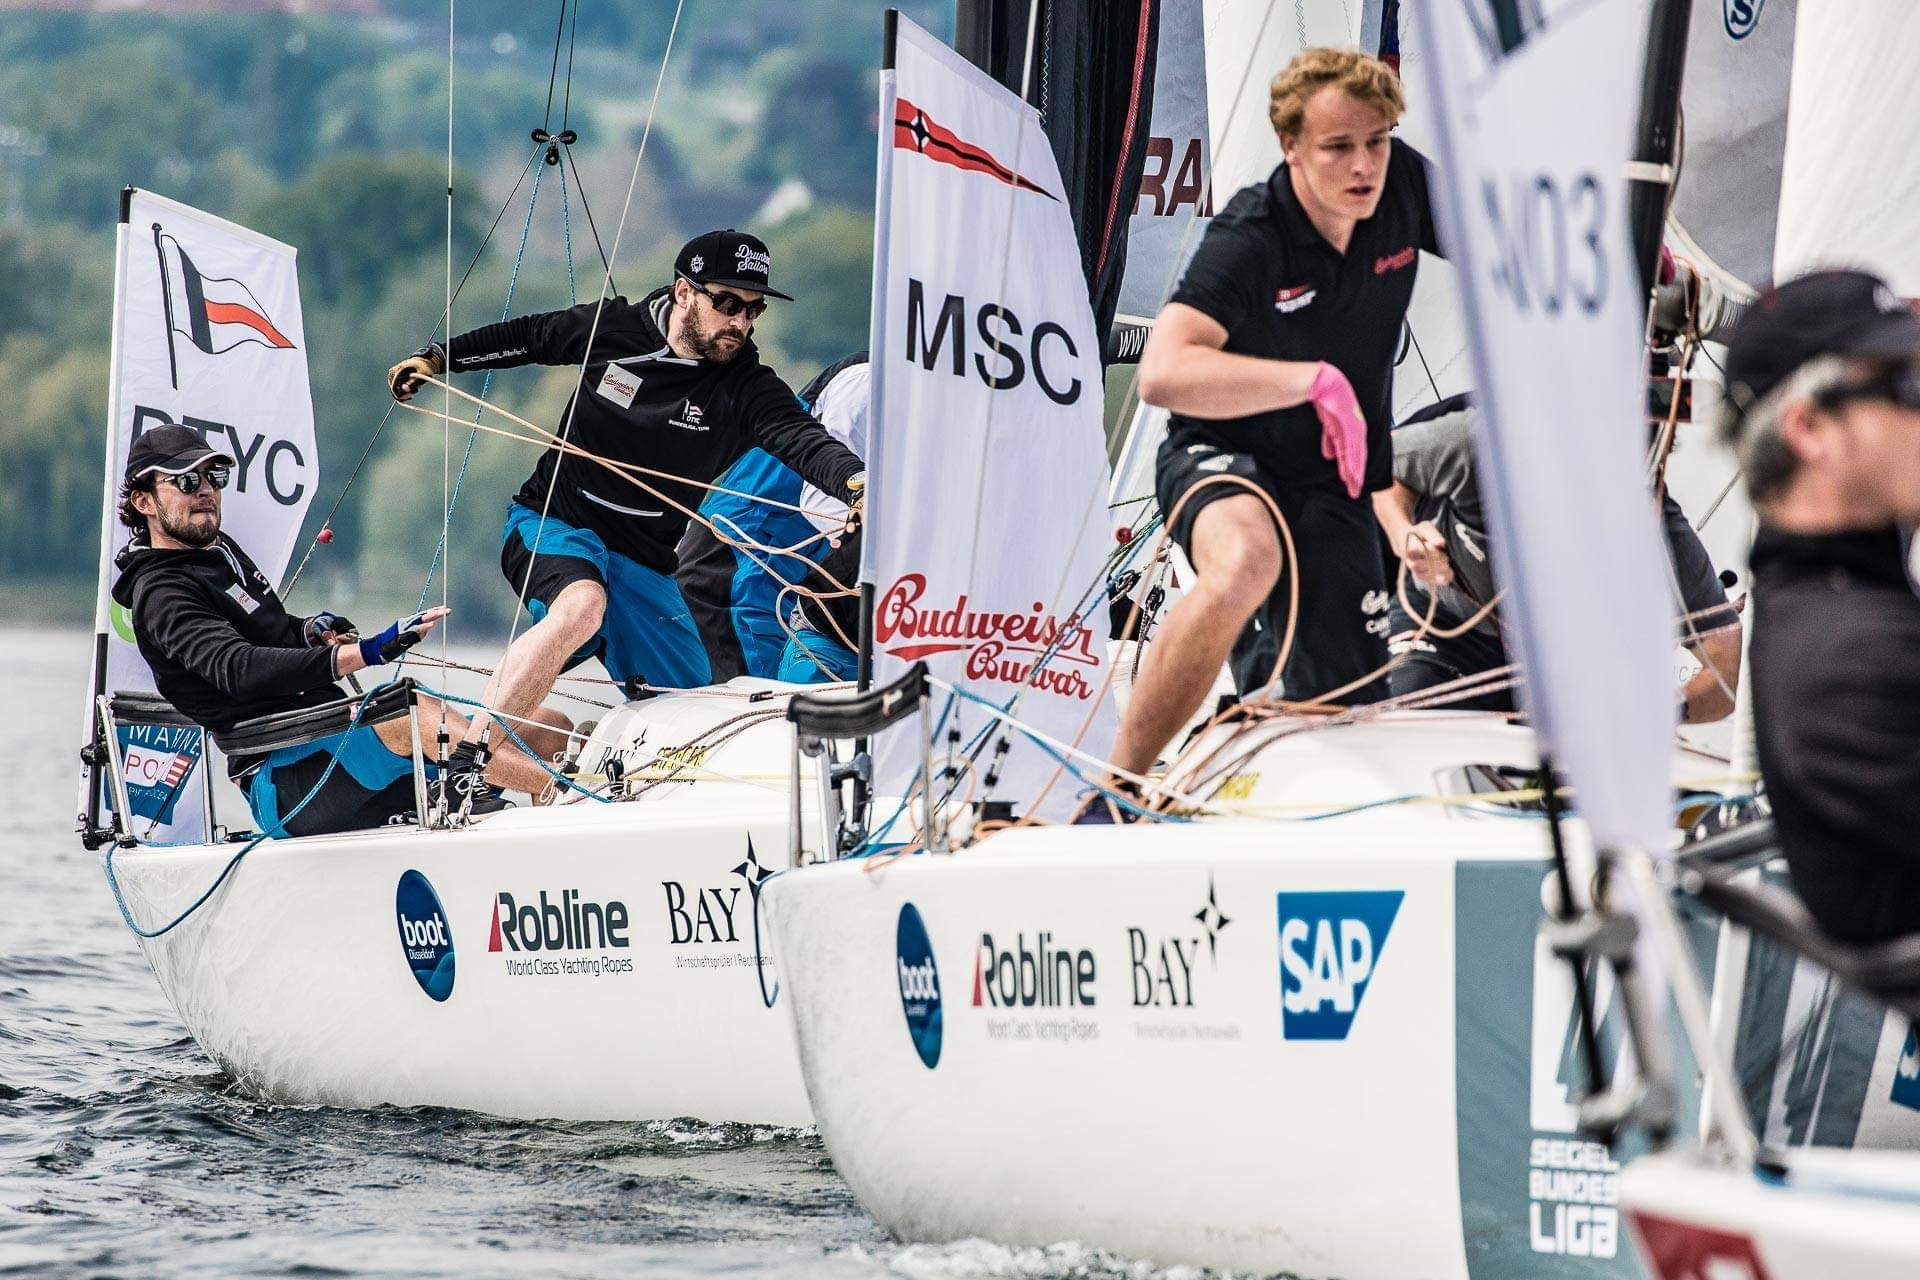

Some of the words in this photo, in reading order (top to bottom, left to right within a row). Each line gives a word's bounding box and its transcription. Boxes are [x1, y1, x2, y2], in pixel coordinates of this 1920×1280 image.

[1131, 136, 1213, 217] RA
[906, 277, 1082, 406] MSC
[875, 572, 1099, 666] Budweiser
[400, 912, 448, 947] boot
[488, 888, 630, 953] Robline
[662, 881, 741, 945] BAY
[506, 958, 535, 976] World
[534, 957, 559, 976] Class
[559, 956, 600, 977] Yachting
[601, 955, 633, 975] Ropes
[899, 955, 938, 1000] boot
[971, 931, 1096, 1008] Robline
[1128, 927, 1200, 1006] BAY
[1281, 917, 1373, 1014] SAP
